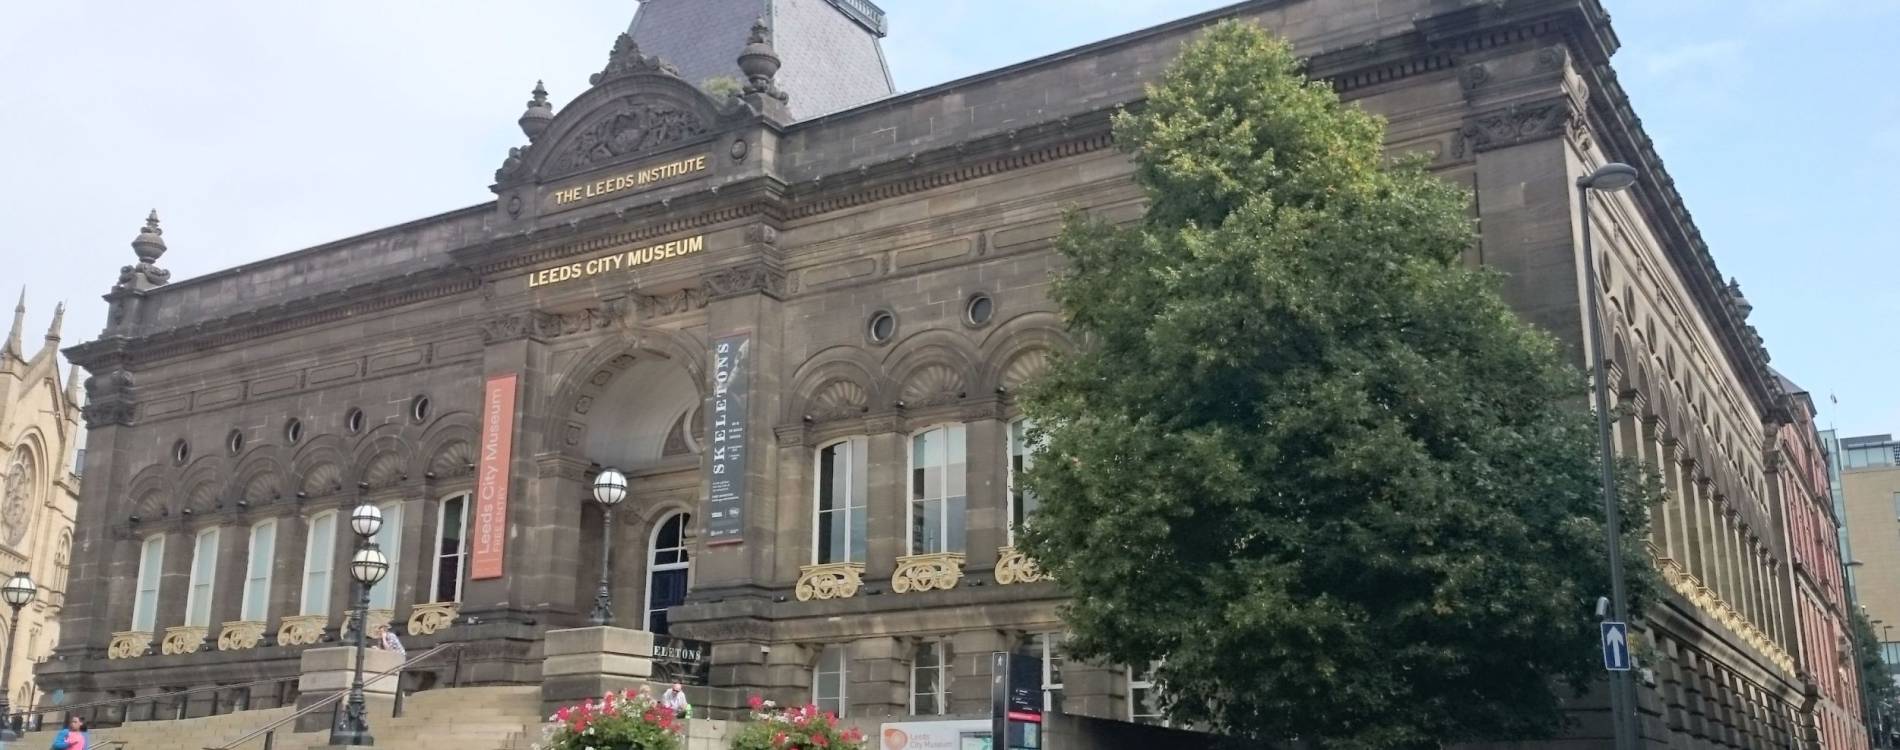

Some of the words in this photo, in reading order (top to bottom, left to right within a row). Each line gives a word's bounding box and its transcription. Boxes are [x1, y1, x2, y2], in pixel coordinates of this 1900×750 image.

[555, 187, 583, 205] THE
[586, 174, 634, 198] LEEDS
[638, 156, 706, 185] INSTITUTE
[529, 263, 582, 288] LEEDS
[586, 253, 625, 275] CITY
[627, 236, 703, 267] MUSEUM
[485, 388, 502, 461] Museum
[712, 342, 730, 475] SKELETONS
[482, 464, 498, 501] City
[494, 485, 506, 522] ENTRY
[477, 504, 494, 554] Leeds
[492, 523, 503, 553] FREE
[653, 645, 701, 661] ELETONS
